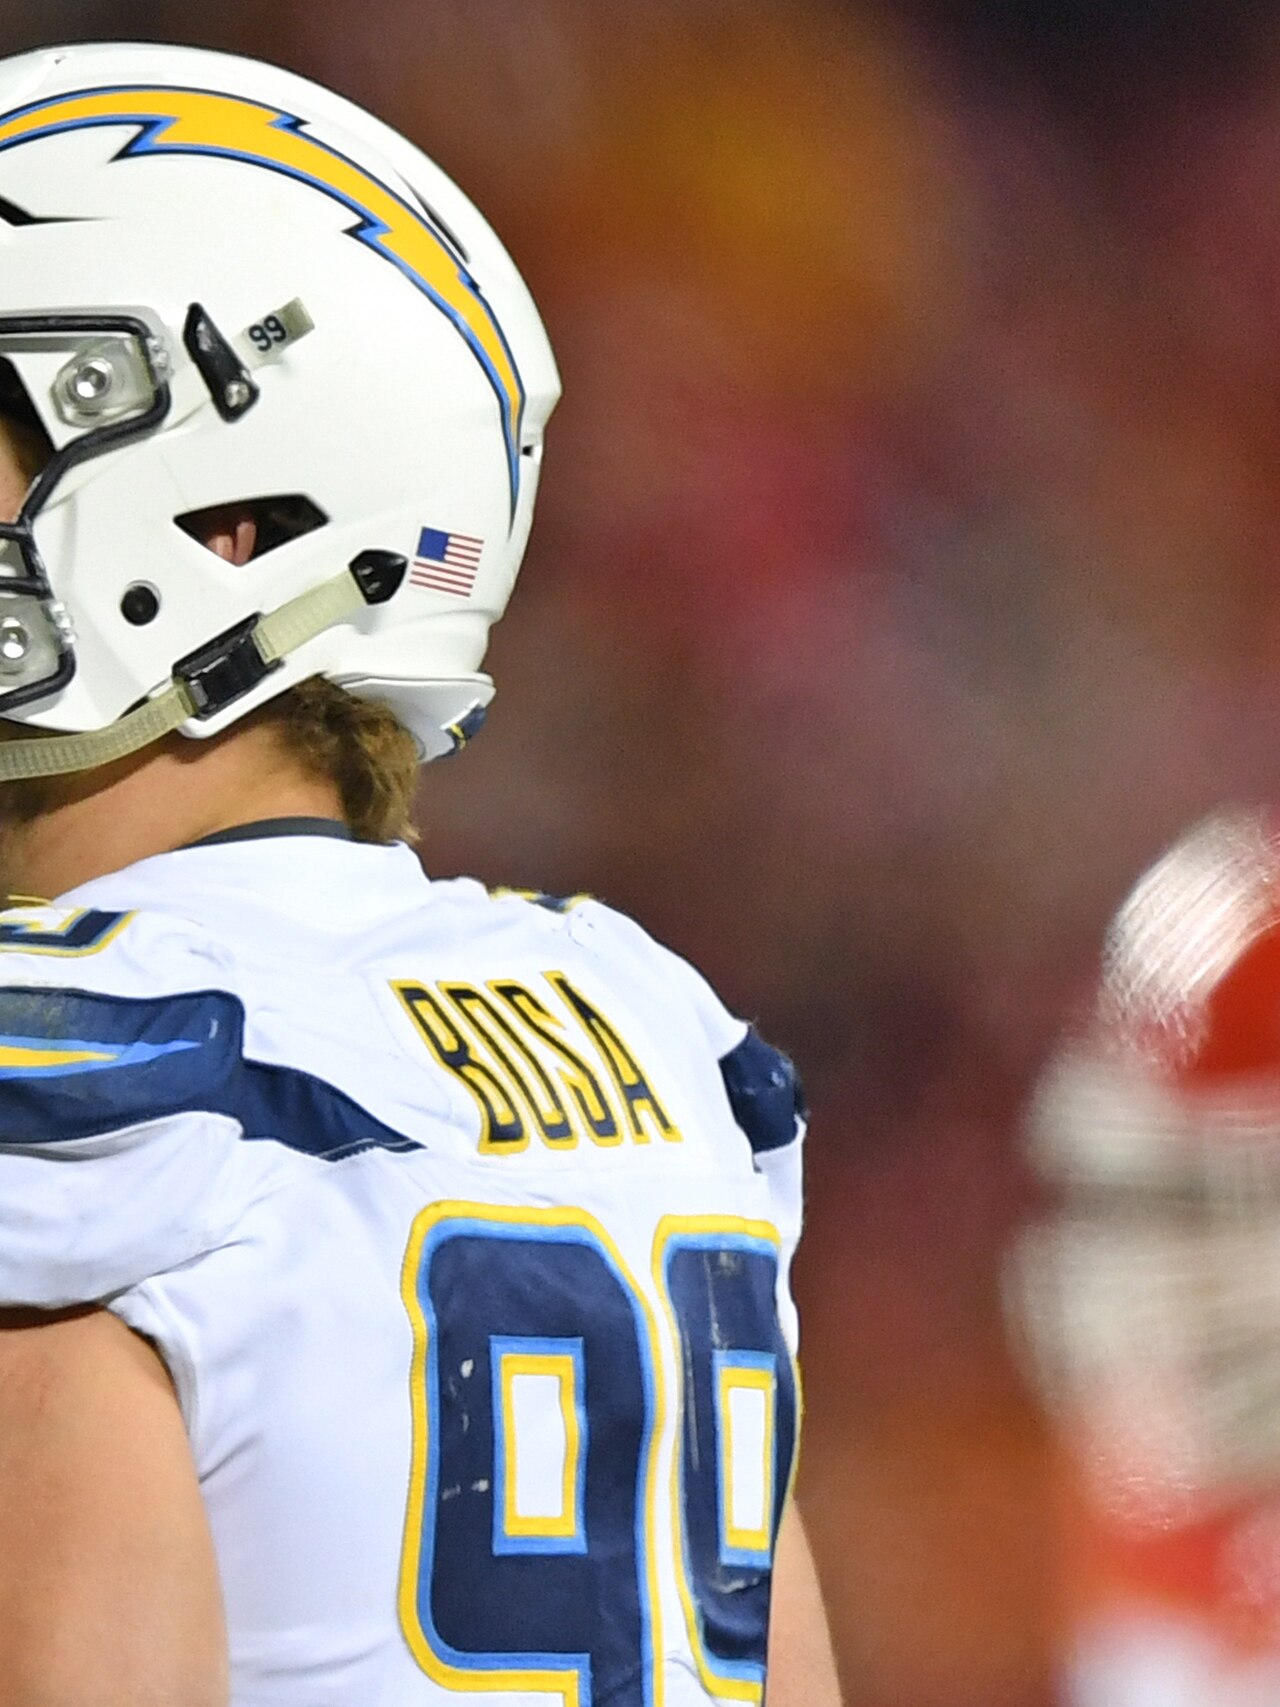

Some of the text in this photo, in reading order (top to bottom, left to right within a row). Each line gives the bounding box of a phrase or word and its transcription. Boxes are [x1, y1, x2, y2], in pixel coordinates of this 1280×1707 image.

[248, 315, 287, 352] 99
[387, 970, 683, 1156] BOSA
[399, 1200, 804, 1707] 99
